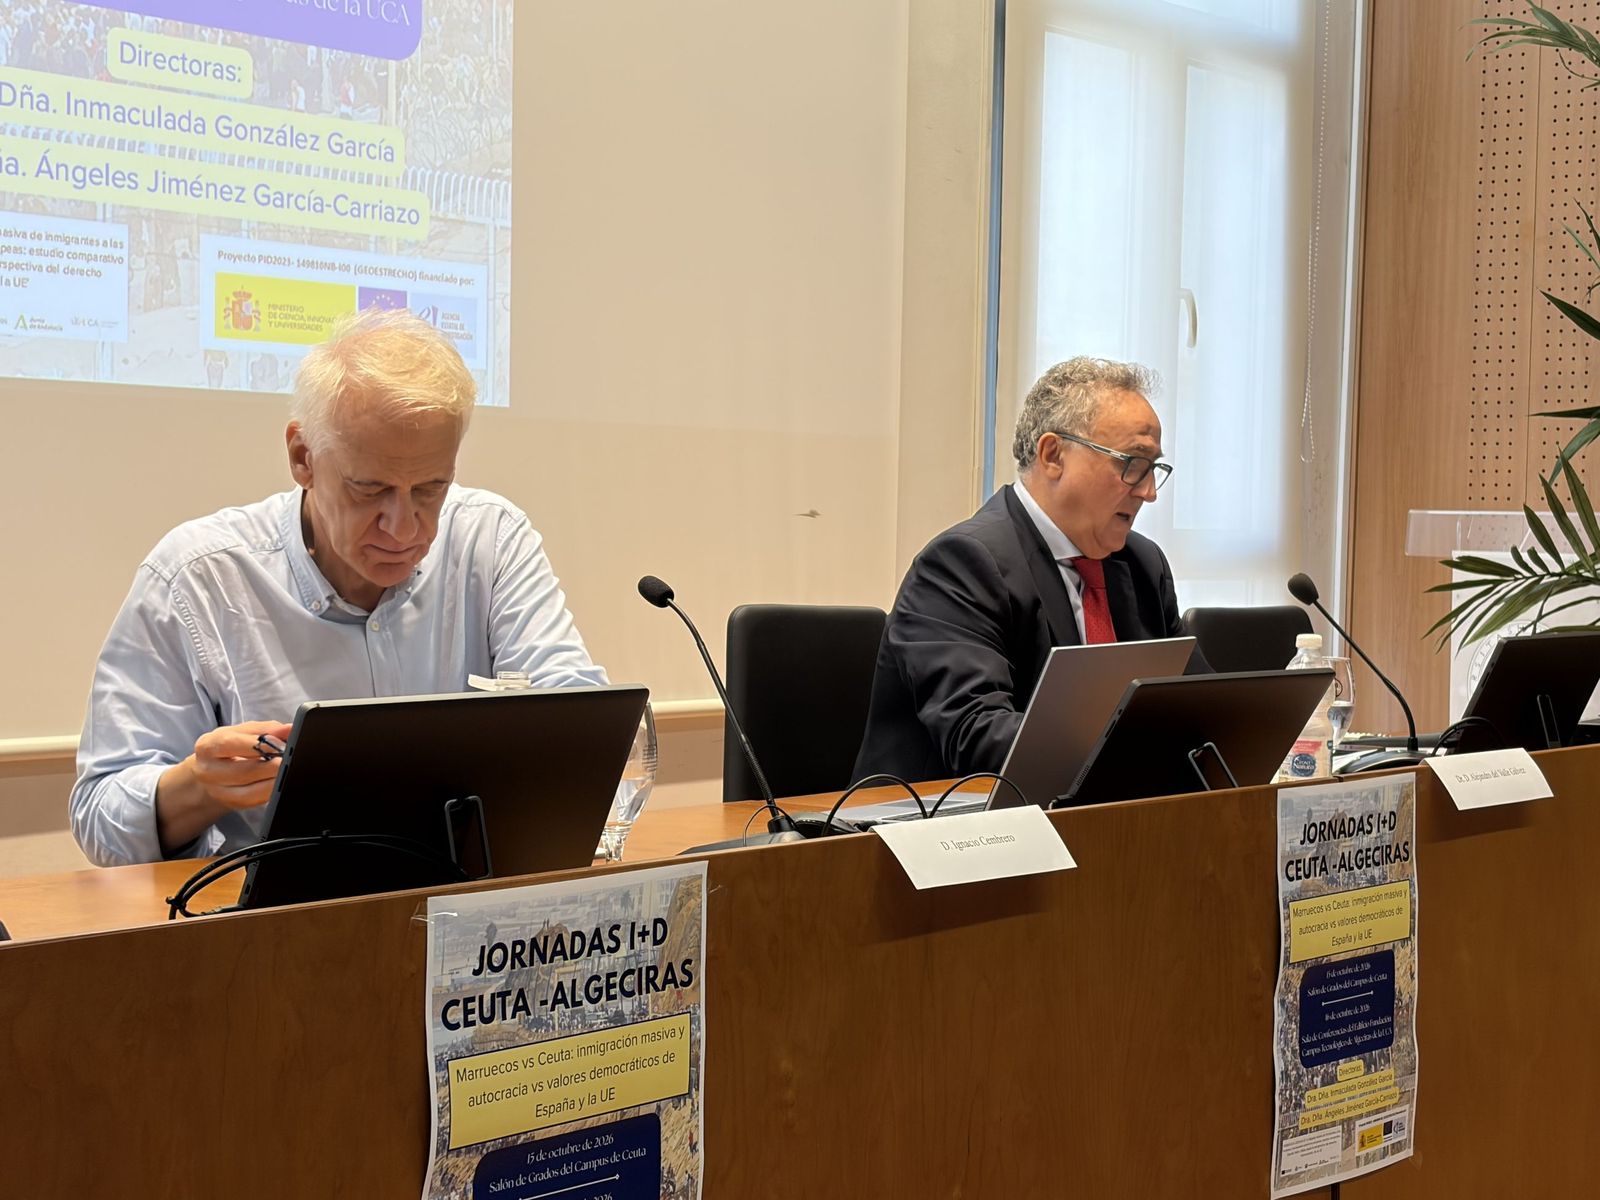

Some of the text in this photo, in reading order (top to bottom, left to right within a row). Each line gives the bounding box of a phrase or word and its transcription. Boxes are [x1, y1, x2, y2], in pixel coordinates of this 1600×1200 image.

[119, 40, 243, 83] Directoras:
[0, 82, 395, 163] Dña. Inmaculada González García
[35, 149, 139, 191] Ángeles
[147, 169, 247, 205] Jiménez
[253, 188, 420, 225] García-Carriazo
[29, 247, 64, 258] estudio
[66, 250, 124, 264] comparativo
[30, 231, 43, 240] de
[45, 232, 100, 246] inmigrantes
[46, 264, 60, 273] del
[63, 265, 102, 278] derecho
[217, 250, 256, 263] Proyecto
[419, 271, 457, 285] financiado
[940, 833, 1016, 851] D. Ignacio Cembrero
[1300, 810, 1397, 846] JORNADAS I+D
[1285, 841, 1409, 882] CEUTA -ALGECIRAS
[1293, 906, 1324, 918] Marruecos
[1324, 903, 1332, 912] vs
[1351, 893, 1383, 907] inmigración
[1383, 890, 1403, 900] masiva
[1298, 906, 1403, 936] autocracia vs valores democráticos de
[472, 917, 668, 976] JORNADAS I+D
[1331, 934, 1352, 947] España
[1358, 932, 1363, 941] la
[1364, 928, 1372, 940] UE
[441, 959, 693, 1031] CEUTA -ALGECIRAS
[456, 1025, 685, 1083] Marruecos vs Ceuta: inmigración masiva y
[468, 1051, 676, 1108] autocracia vs valores democráticos de
[535, 1087, 616, 1119] España y la UE
[527, 1133, 614, 1165] 15 de octubre de 2026
[489, 1147, 647, 1193] Salón de Grados del Campus de Ceuta
